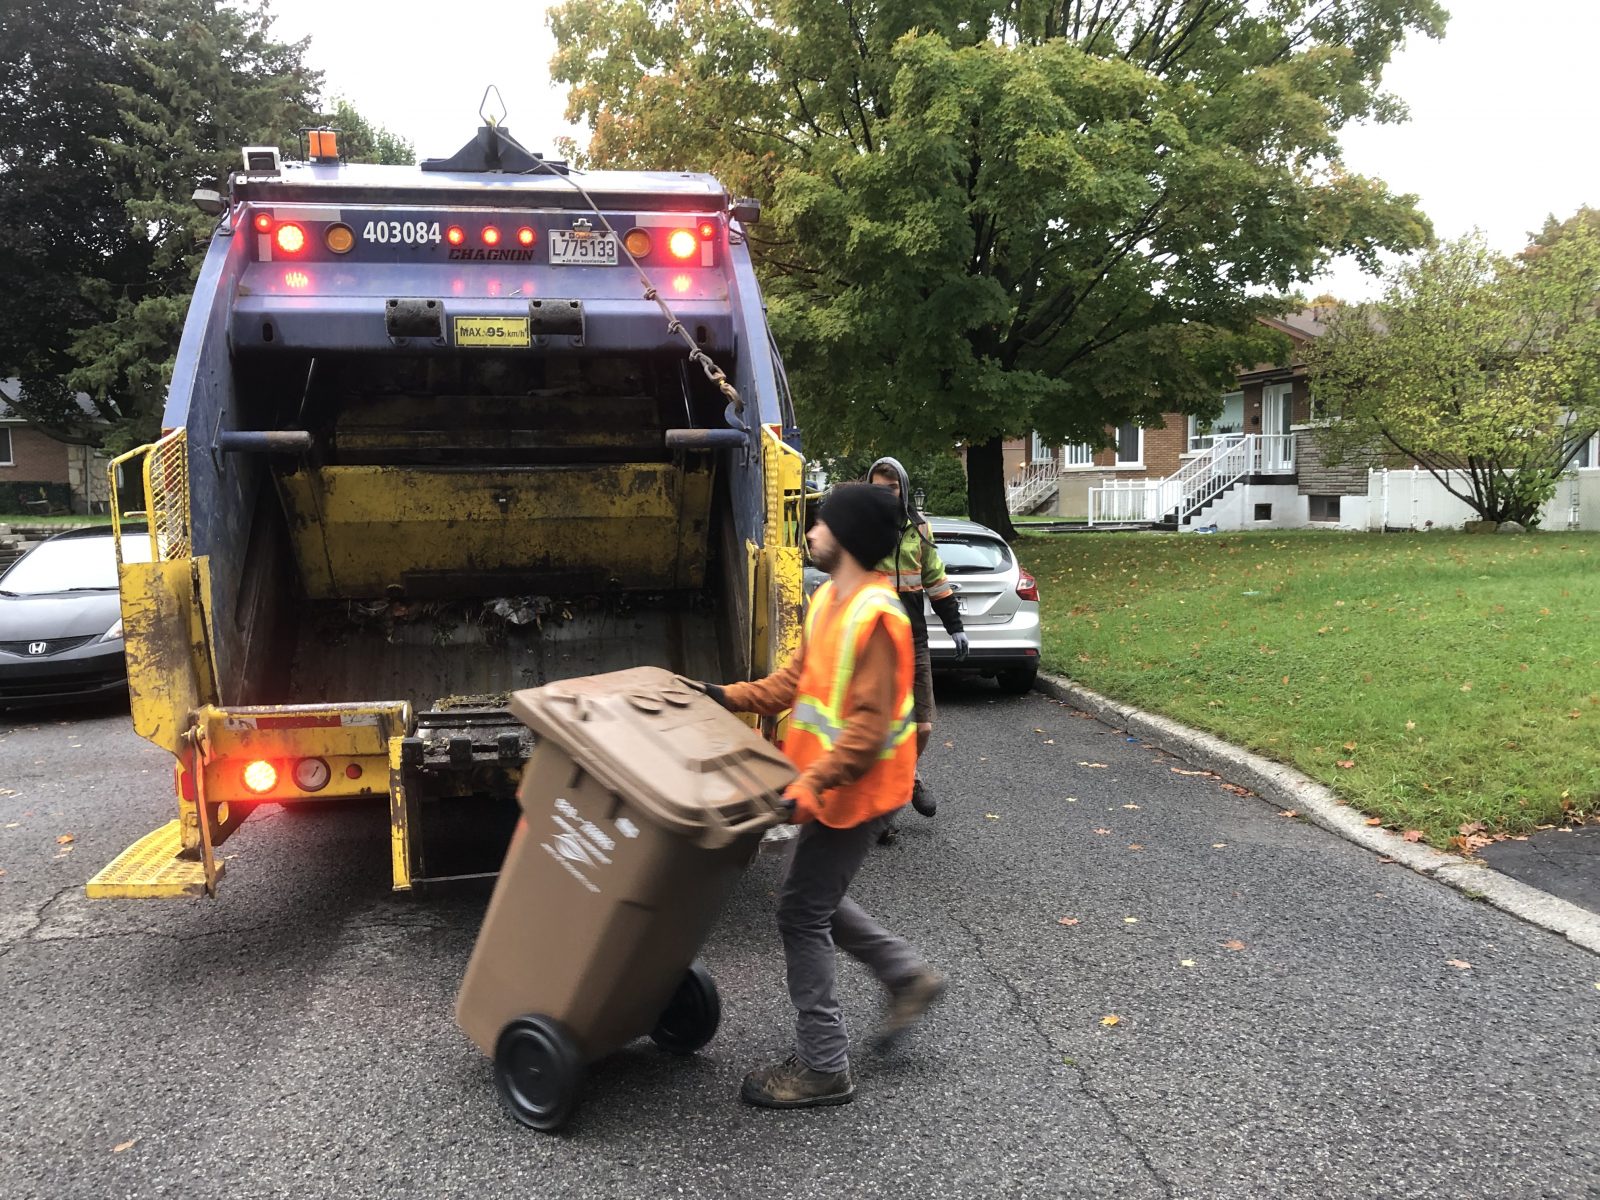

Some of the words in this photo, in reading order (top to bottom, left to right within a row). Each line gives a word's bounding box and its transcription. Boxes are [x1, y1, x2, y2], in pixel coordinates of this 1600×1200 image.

[363, 221, 442, 243] 403084
[448, 249, 534, 261] CHAGNON
[553, 239, 614, 257] L775133
[487, 327, 504, 337] 95
[507, 329, 525, 338] km/h
